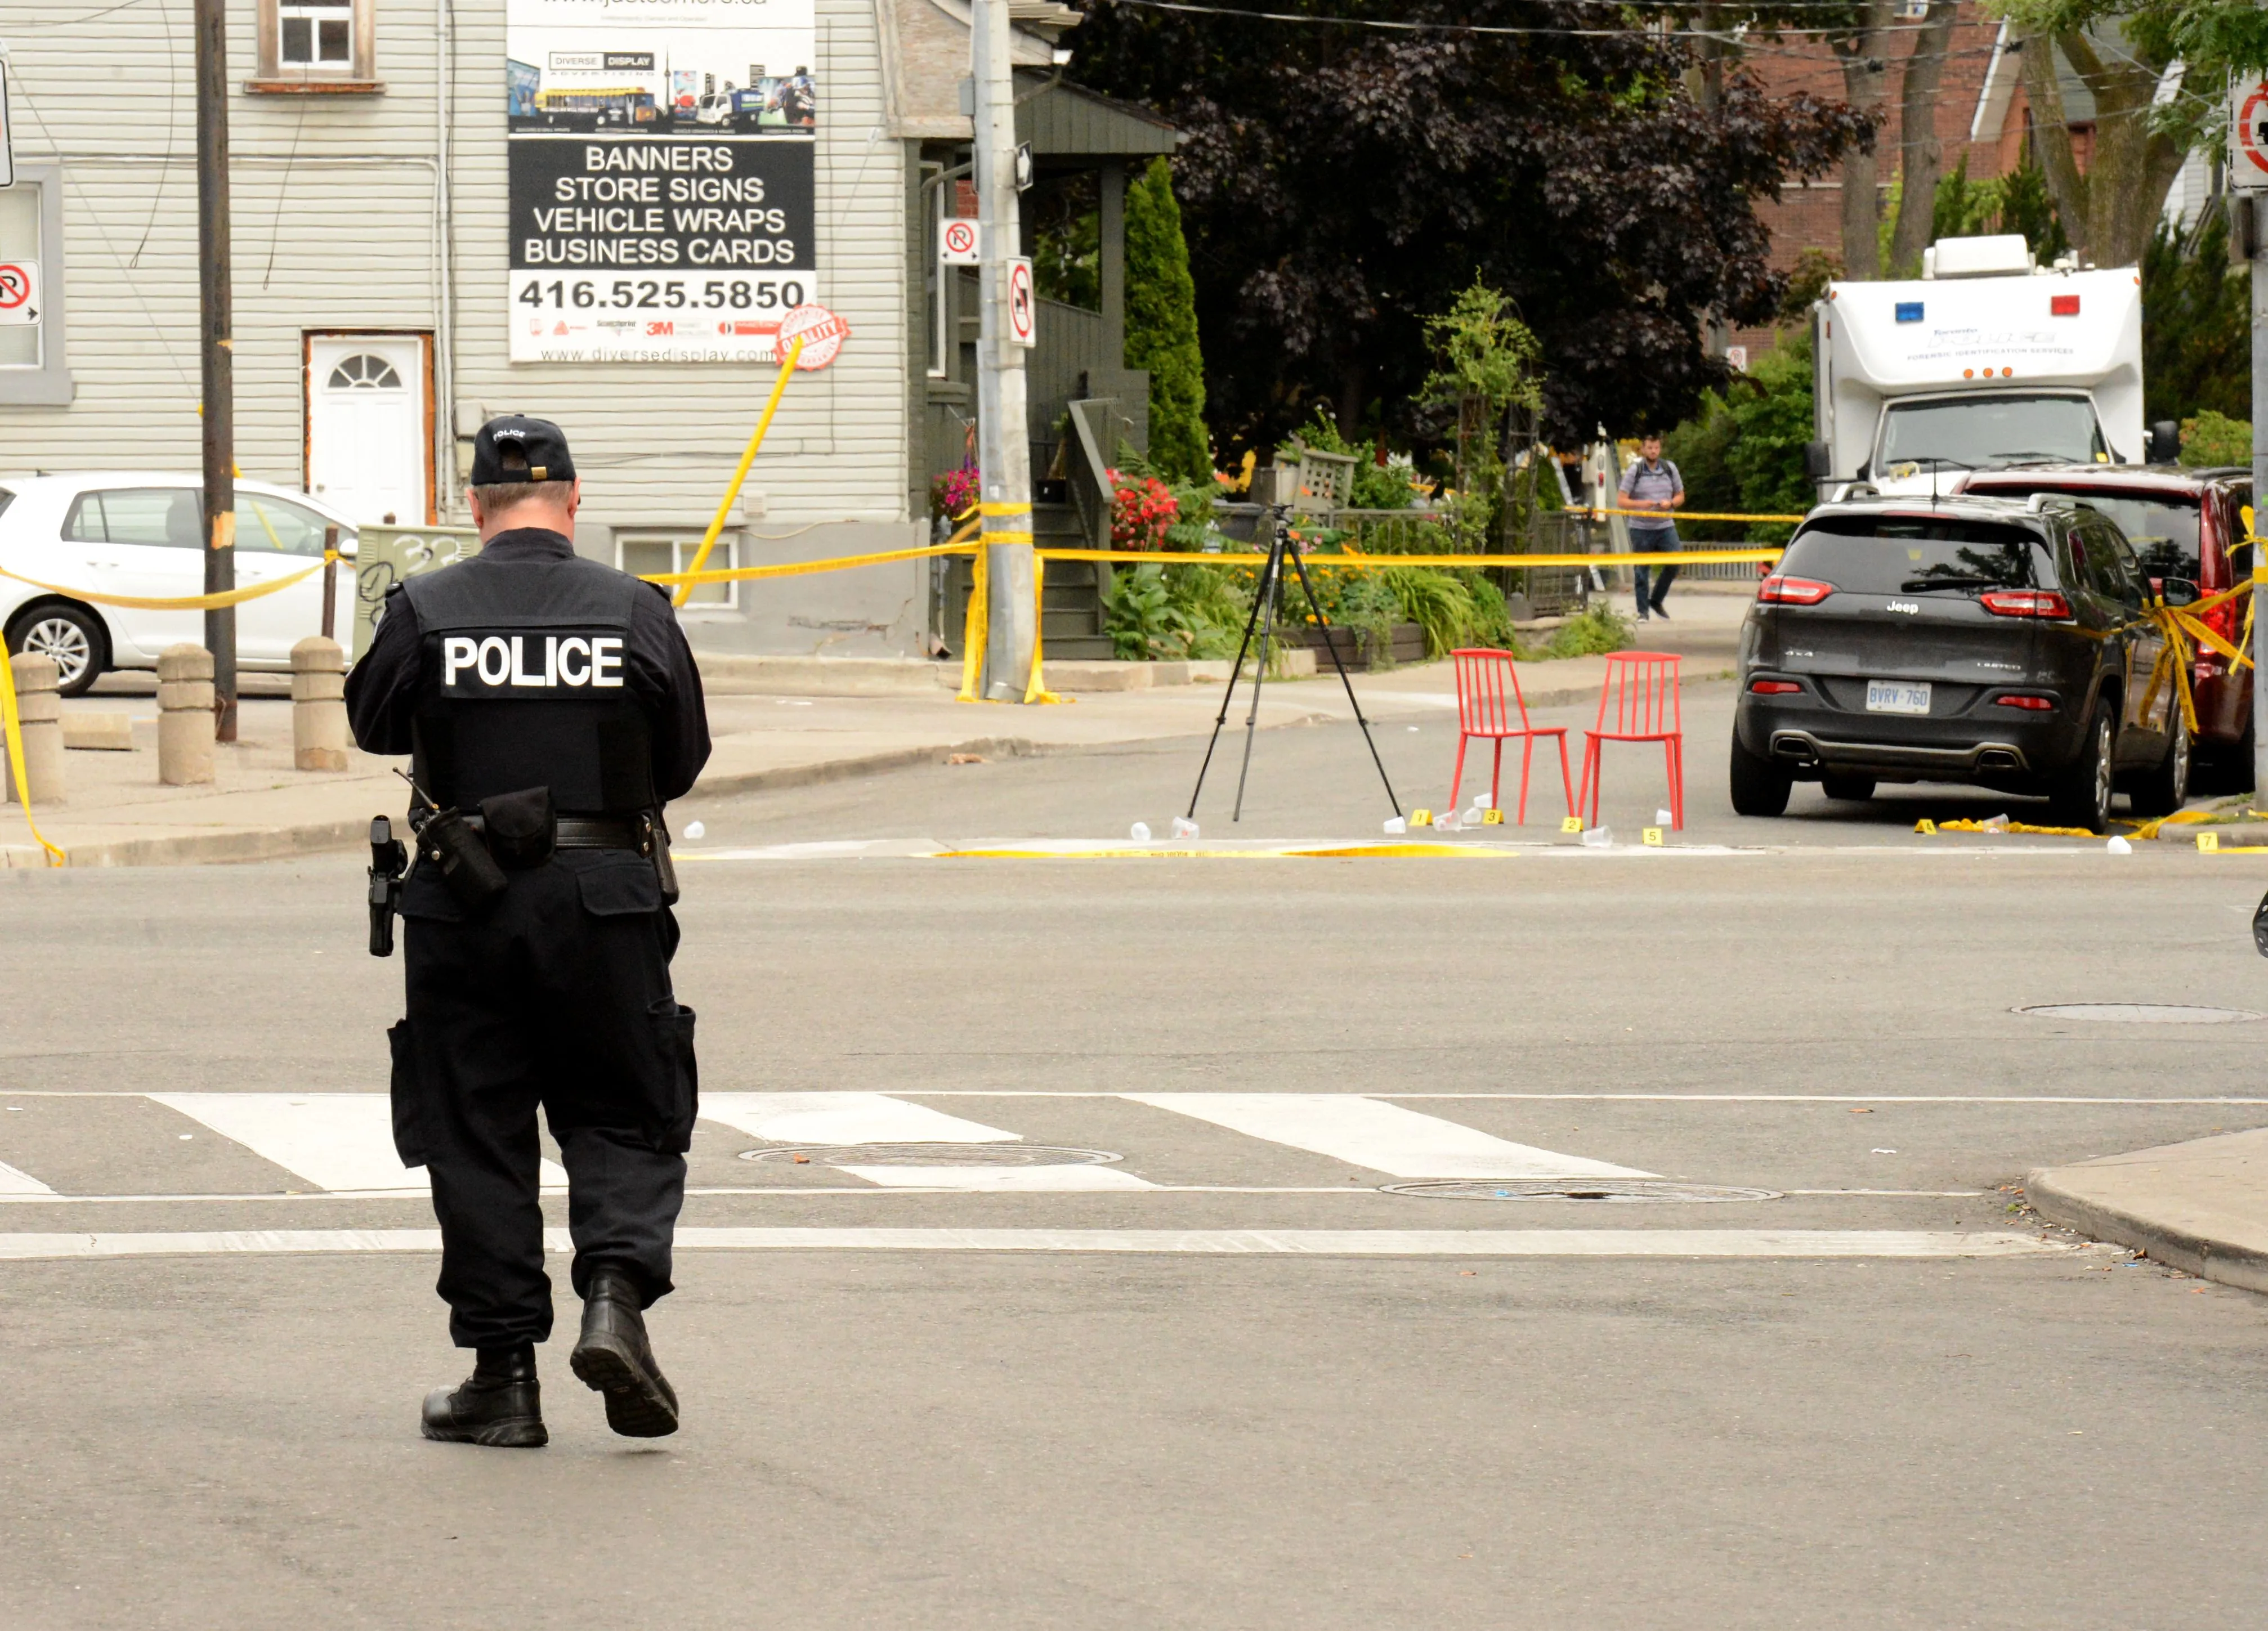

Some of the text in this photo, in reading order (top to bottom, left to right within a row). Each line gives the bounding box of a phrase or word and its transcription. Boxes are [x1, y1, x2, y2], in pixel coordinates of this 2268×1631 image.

[555, 56, 651, 66] DIVERSE DISPLAY
[586, 146, 733, 171] BANNERS
[556, 177, 764, 203] STORE SIGNS
[534, 208, 786, 234] VEHICLE WRAPS
[525, 239, 795, 264] BUSINESS CARDS
[519, 281, 804, 309] 416.525.5850
[646, 321, 674, 336] 3M
[1934, 328, 1978, 337] Toronto
[1907, 346, 2074, 361] FORENSIC IDENTIFICATION SERVICES
[493, 429, 526, 442] POLICE
[1886, 601, 1919, 615] Jeep
[444, 636, 624, 687] POLICE
[1869, 687, 1929, 707] BVRV 760
[1418, 813, 1422, 822] 1
[1488, 812, 1496, 822] 3
[1568, 819, 1576, 830] 2
[1926, 822, 1933, 832] 4
[1649, 831, 1657, 841] 5
[2204, 835, 2211, 847] 7
